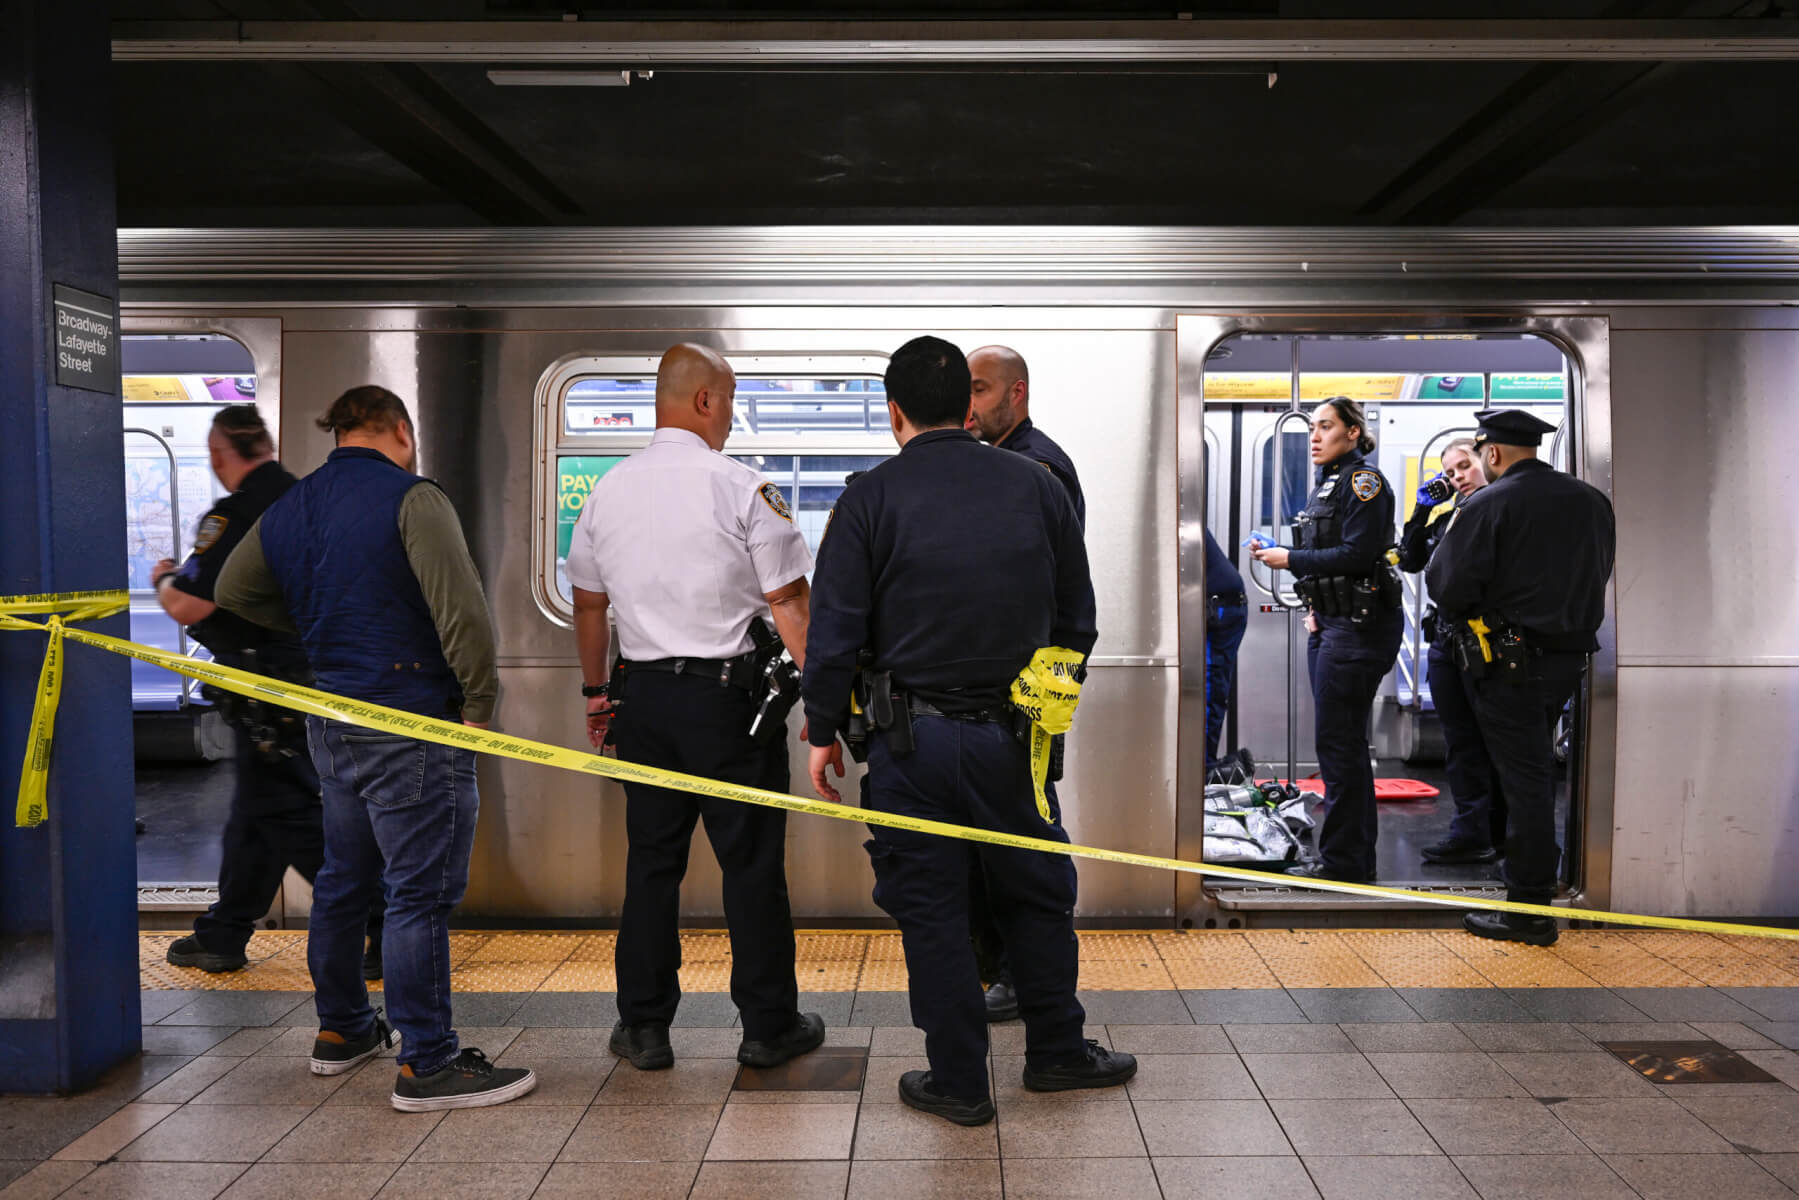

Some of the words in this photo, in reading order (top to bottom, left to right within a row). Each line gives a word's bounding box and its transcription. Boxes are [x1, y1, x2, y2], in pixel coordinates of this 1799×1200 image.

[58, 309, 112, 339] Broadway-
[58, 330, 107, 355] Lafayette
[59, 351, 92, 373] Street
[561, 474, 598, 492] PAY
